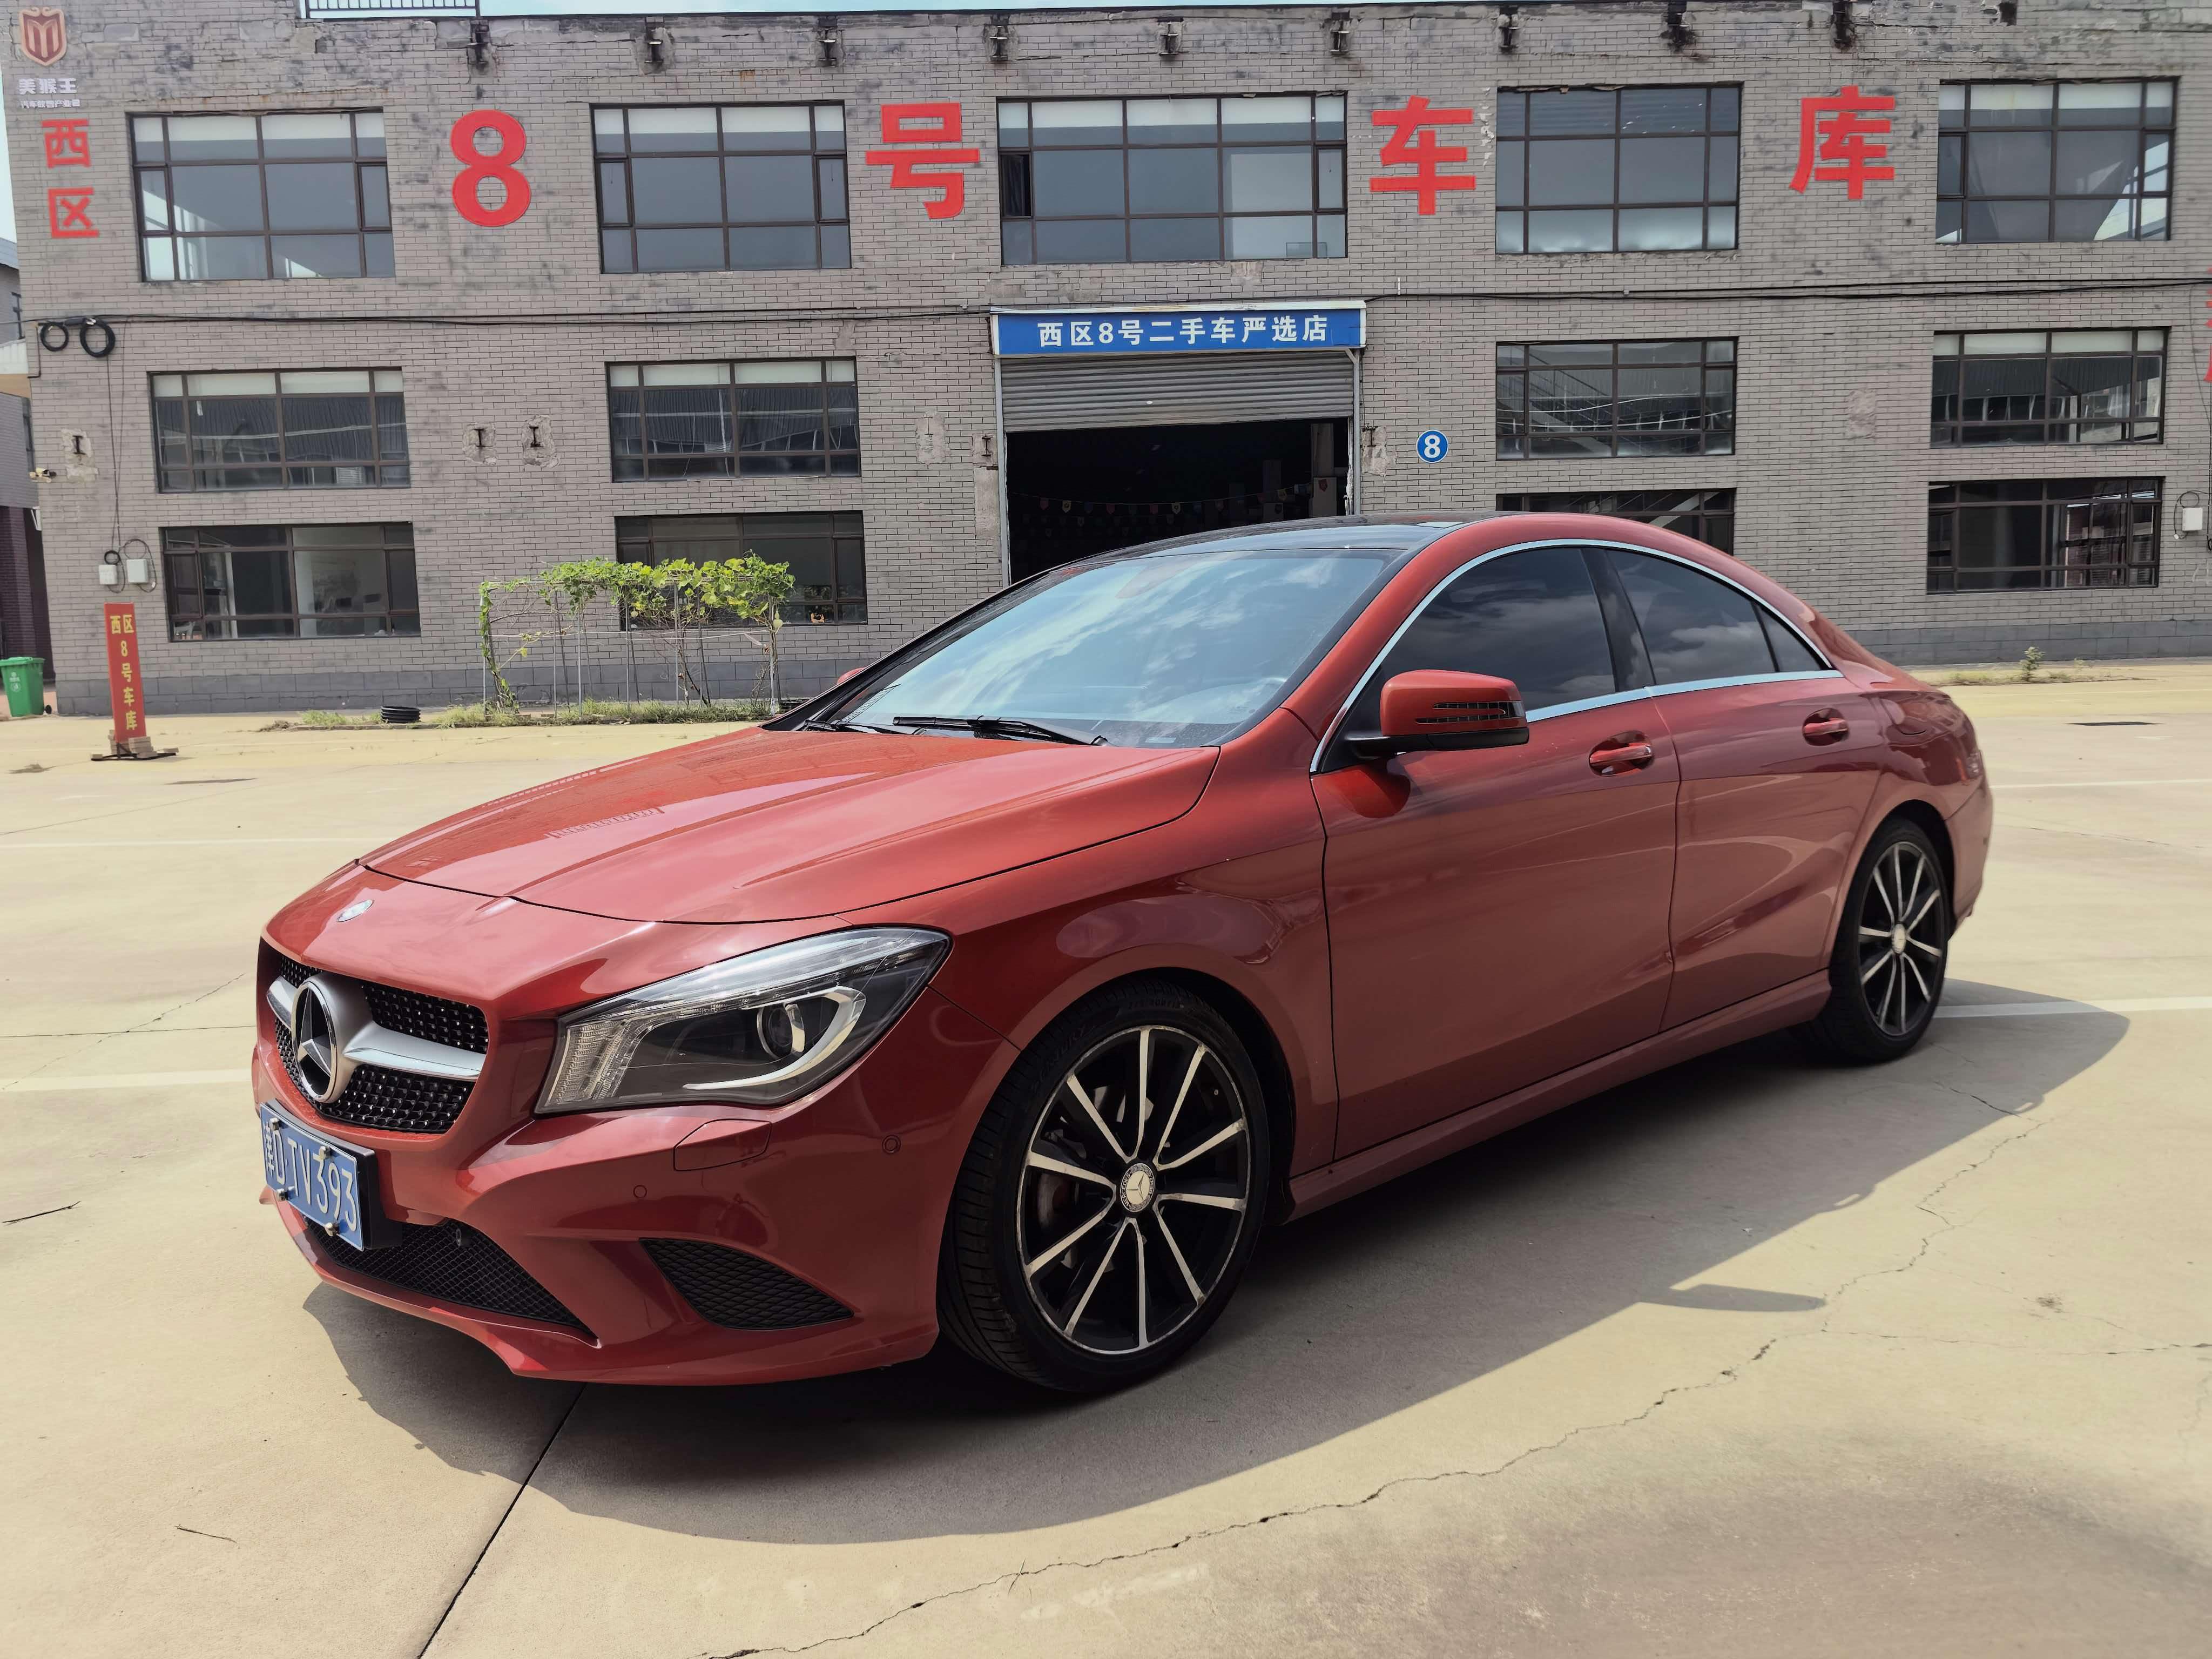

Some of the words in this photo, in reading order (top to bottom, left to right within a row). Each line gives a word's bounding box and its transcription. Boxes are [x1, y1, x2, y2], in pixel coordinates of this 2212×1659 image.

[19, 78, 77, 95] 美猴王
[42, 119, 99, 238] 西区
[1037, 315, 1327, 347] 西区8号二手车严选店
[1424, 435, 1440, 458] 8
[110, 614, 134, 634] 西区
[121, 640, 137, 730] 8号车库
